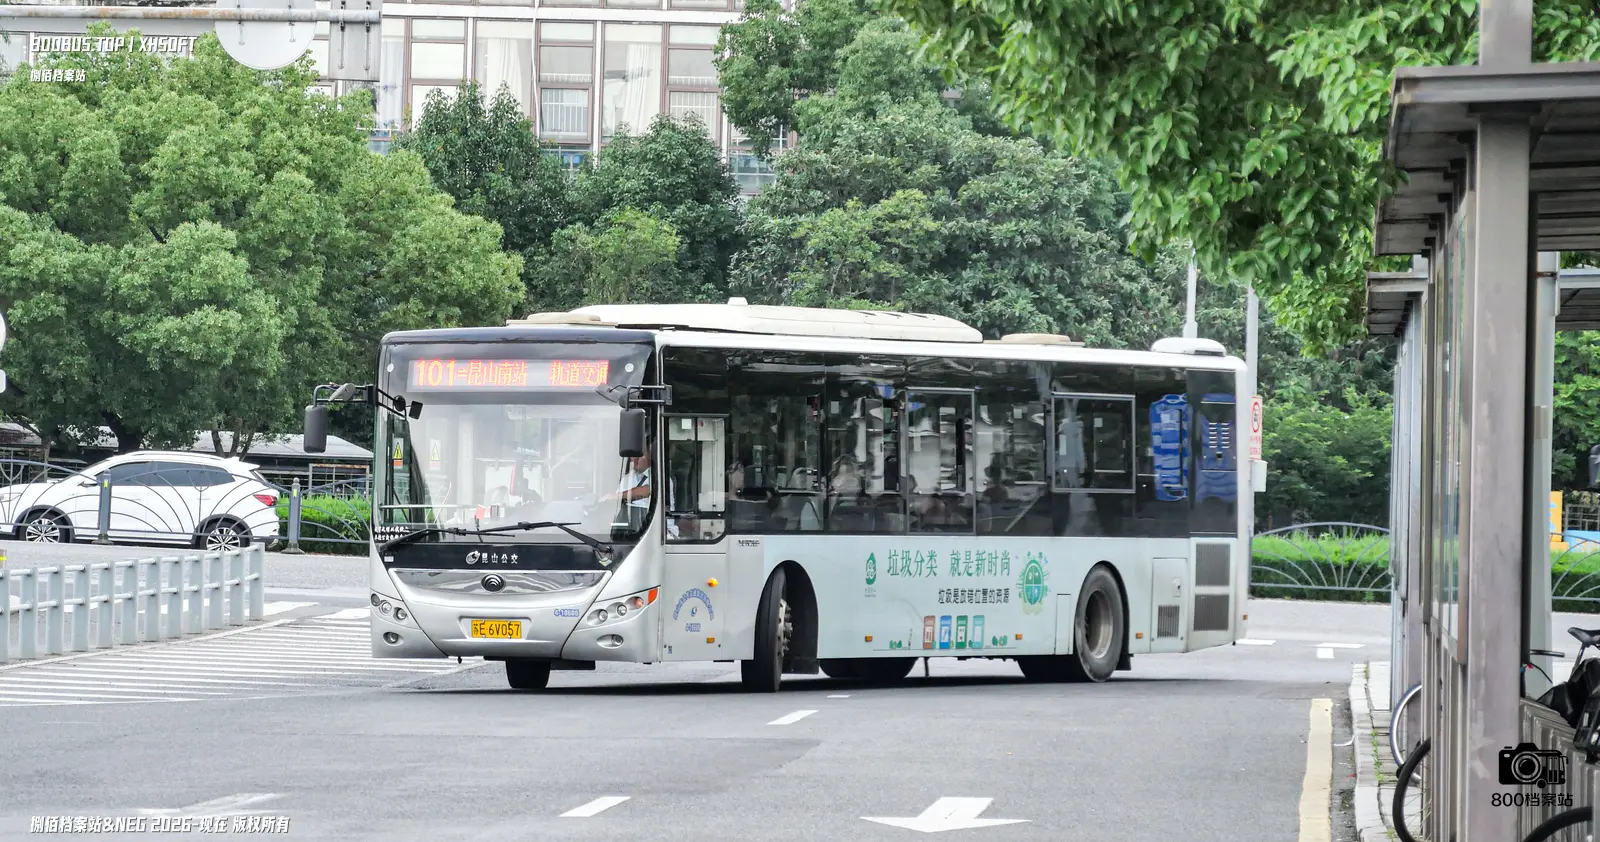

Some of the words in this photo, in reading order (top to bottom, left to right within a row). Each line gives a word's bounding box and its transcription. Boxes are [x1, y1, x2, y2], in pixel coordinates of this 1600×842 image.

[415, 358, 457, 387] 101
[467, 360, 529, 387] 昆山南站
[549, 359, 610, 387] 轨道交通
[481, 552, 519, 564] 昆山公交
[887, 549, 938, 578] 垃圾分类
[949, 549, 1011, 578] 就是新时尚
[938, 587, 1011, 604] 垃圾是放错位置的资源
